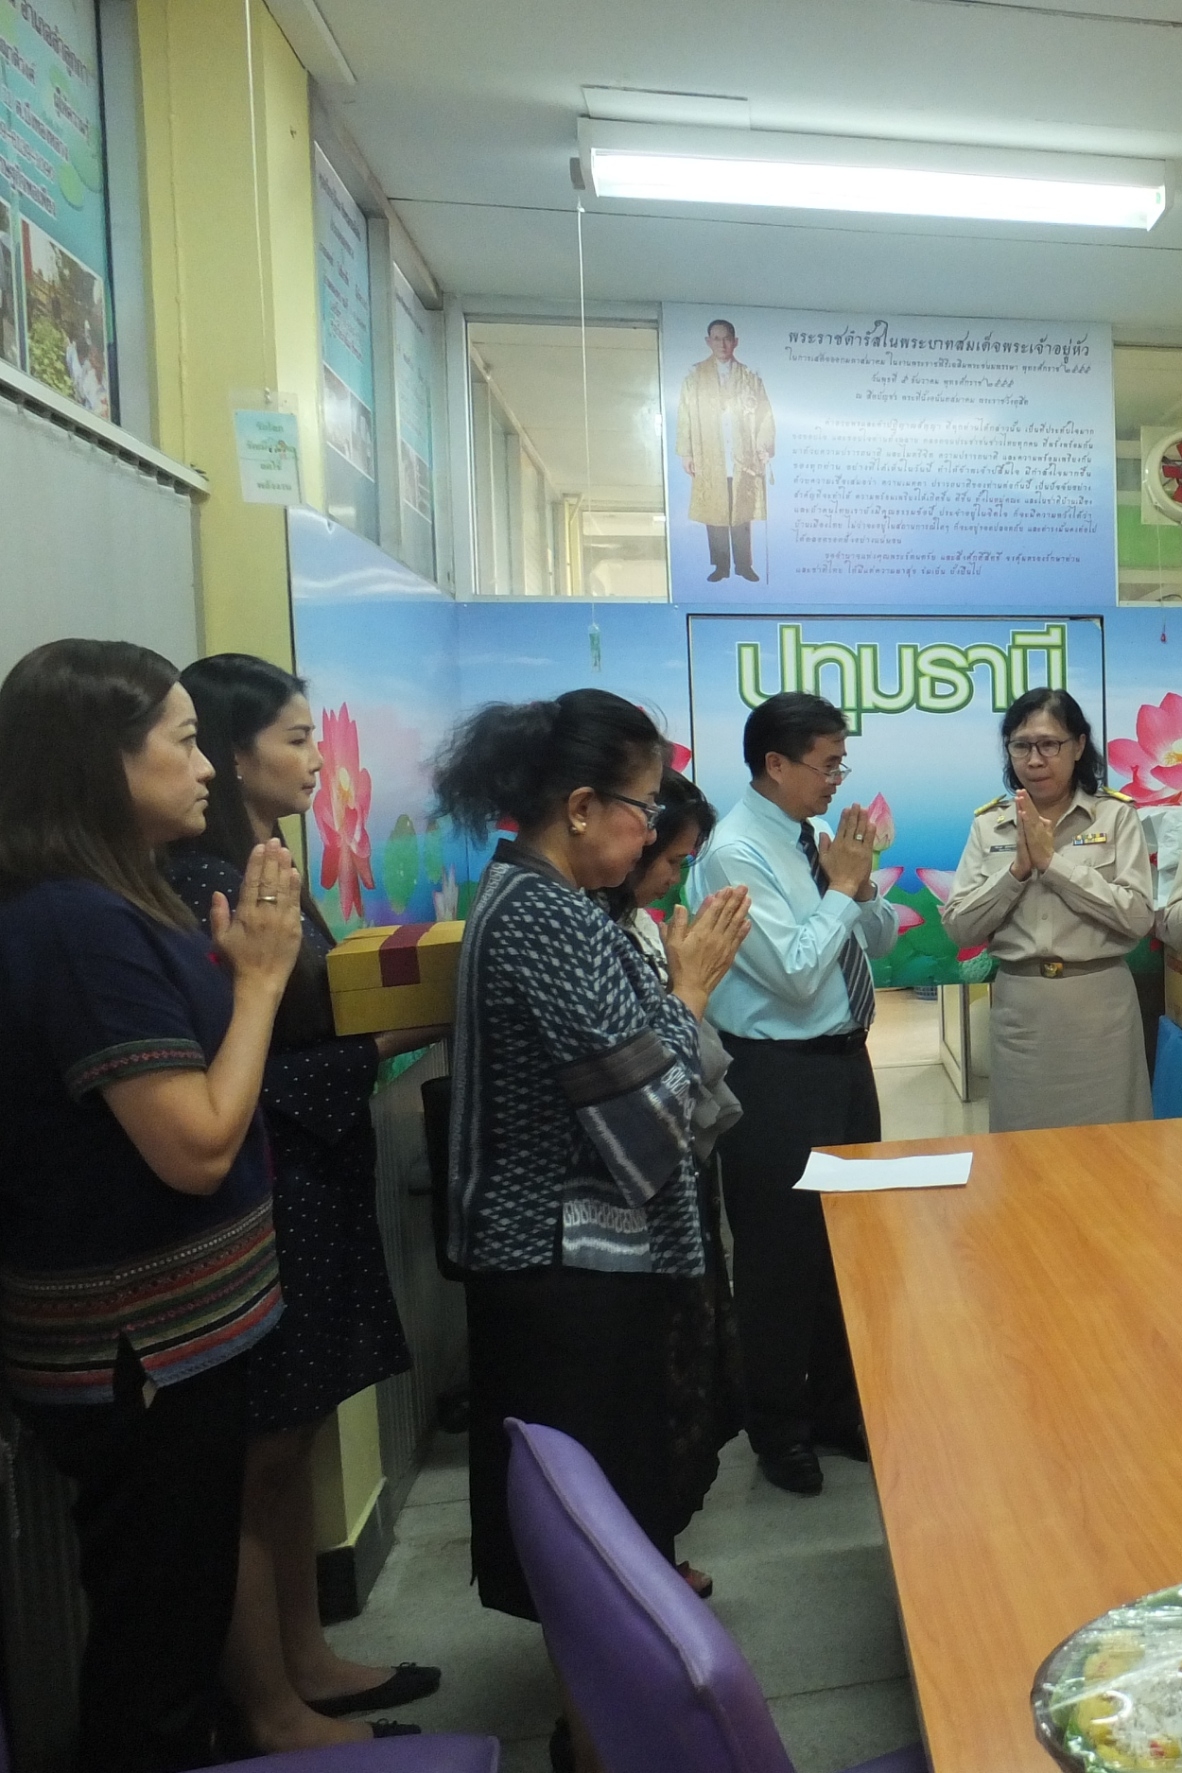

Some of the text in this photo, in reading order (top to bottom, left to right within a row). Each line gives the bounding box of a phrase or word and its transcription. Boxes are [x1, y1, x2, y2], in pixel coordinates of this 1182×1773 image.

[788, 319, 1090, 363] พระราชดำรัสในพระบาทสมเด็จพระเจ้าอยู่หัว
[736, 622, 1068, 736] ปทุมธานี
